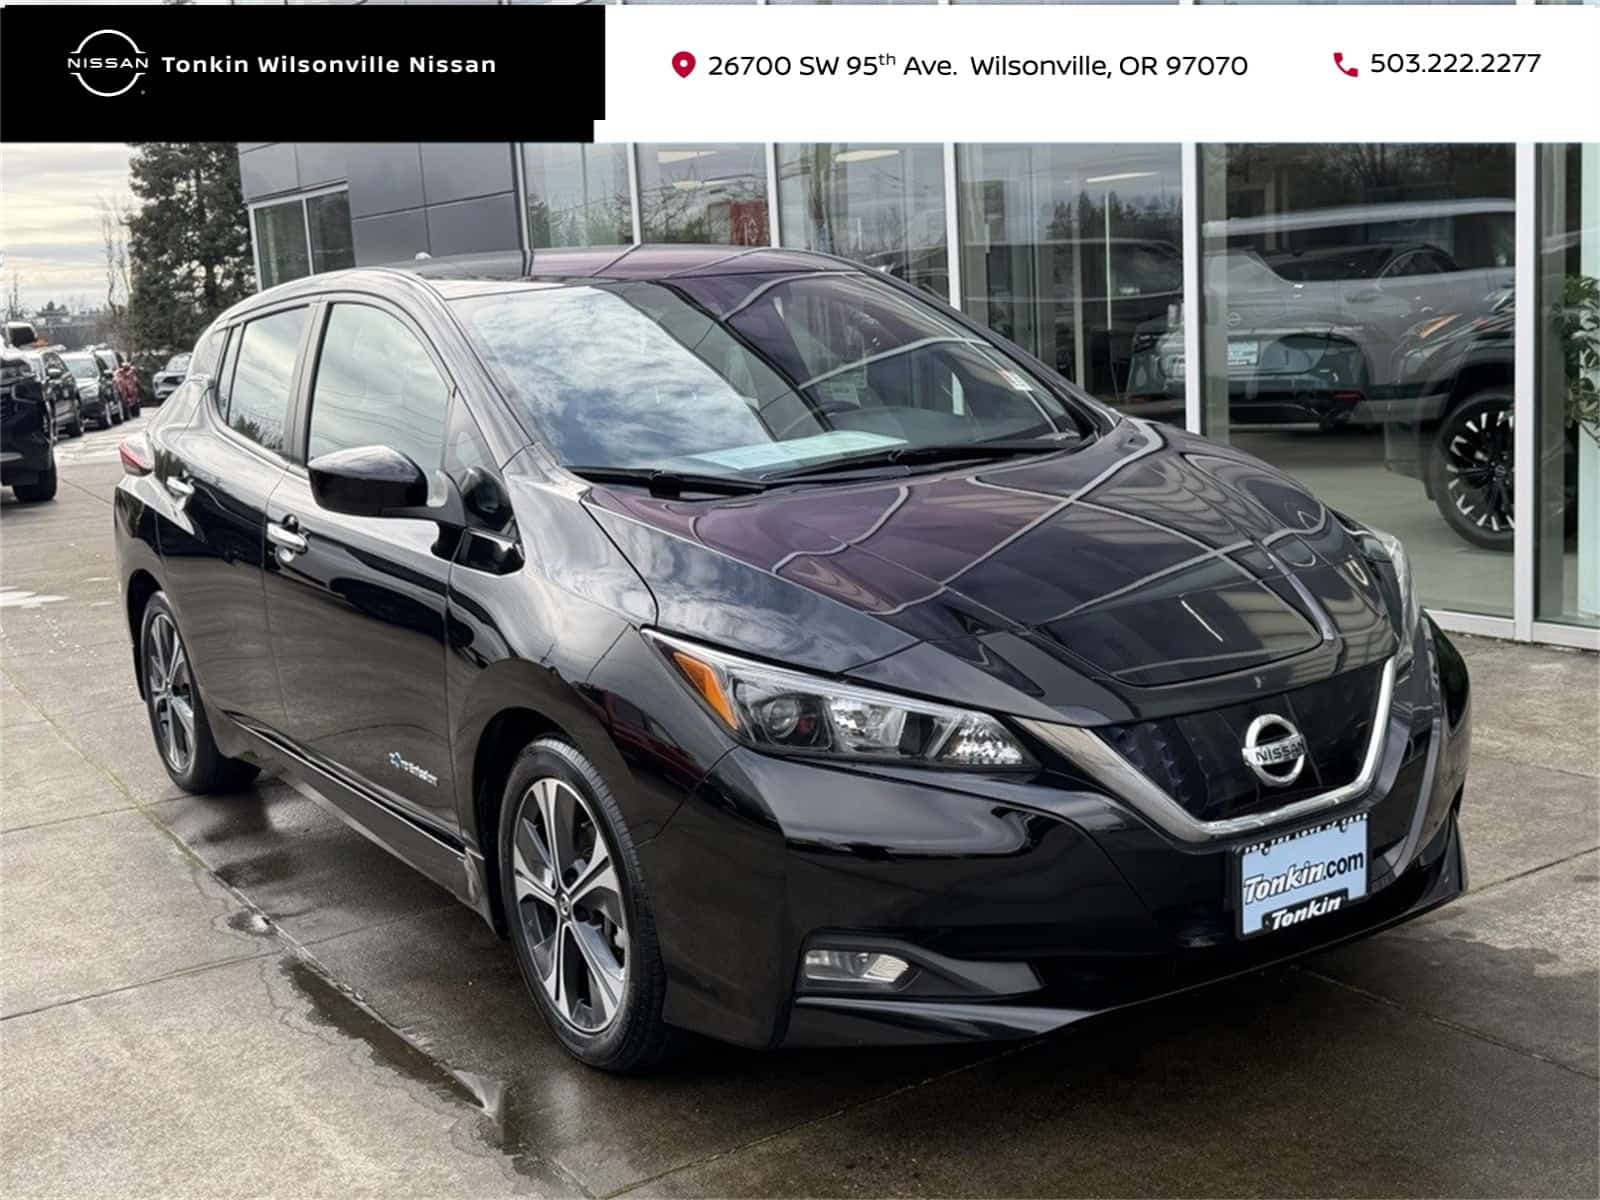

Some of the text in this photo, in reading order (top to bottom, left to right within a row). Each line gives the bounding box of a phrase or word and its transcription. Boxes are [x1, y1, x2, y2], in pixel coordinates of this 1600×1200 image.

[1255, 740, 1306, 761] NISSAN
[1244, 851, 1364, 906] Tonkin.com
[1271, 895, 1342, 930] Tonkin
